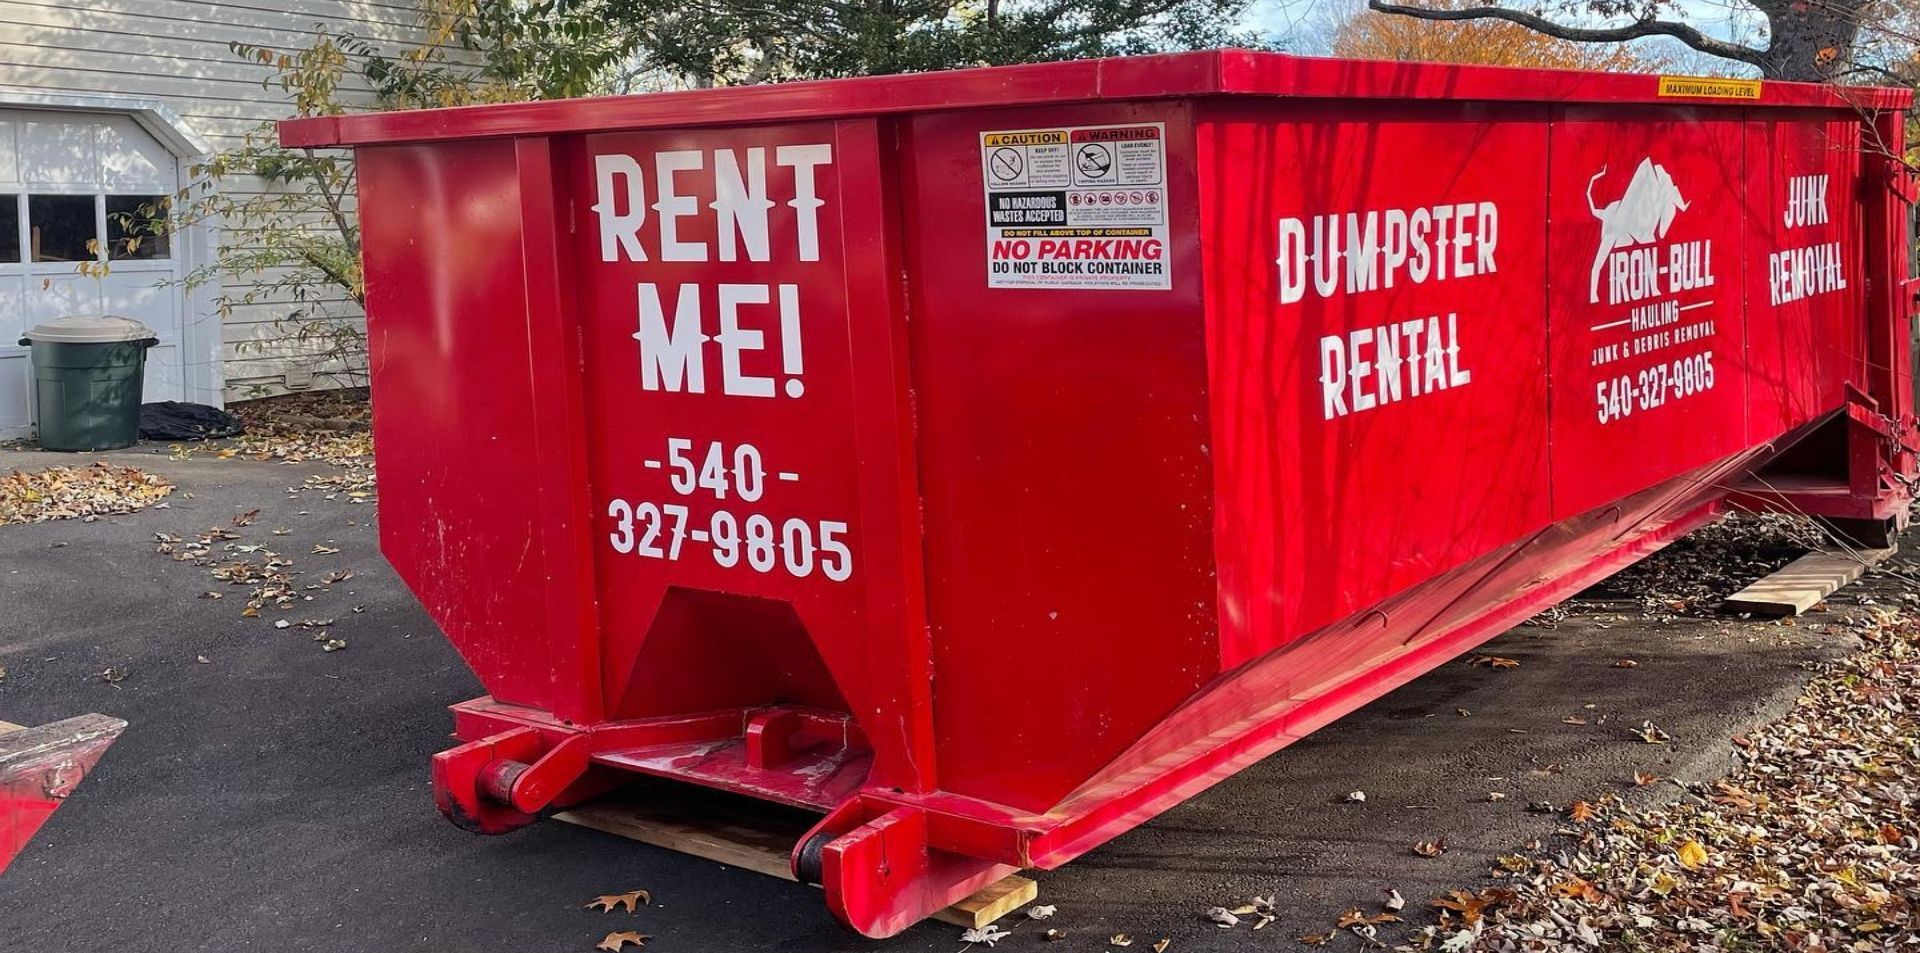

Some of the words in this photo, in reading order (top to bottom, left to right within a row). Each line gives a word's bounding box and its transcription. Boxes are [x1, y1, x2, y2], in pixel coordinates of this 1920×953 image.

[1666, 84, 1702, 94] MAXIMUM
[1703, 85, 1734, 95] LOADING
[1735, 87, 1755, 97] LEVEL
[1001, 133, 1061, 145] CAUTION
[1089, 129, 1154, 140] WARNING
[591, 144, 832, 262] RENT
[993, 210, 1024, 223] WASTES
[1025, 209, 1065, 222] ACCEPTED
[999, 198, 1010, 209] NO
[1012, 196, 1057, 209] HAZARDOUS
[1784, 175, 1829, 229] JUNK
[993, 240, 1030, 259] NO
[1037, 239, 1163, 259] PARKING
[993, 262, 1009, 274] DO
[1014, 262, 1037, 273] NOT
[1042, 262, 1083, 273] BLOCK
[1088, 262, 1162, 274] CONTAINER
[1276, 201, 1498, 305] DUMPSTER
[1609, 239, 1715, 306] IRON-BULL
[1769, 242, 1846, 307] REMOVAL
[632, 282, 805, 399] ME!
[1631, 300, 1680, 332] HAULING
[1319, 312, 1471, 421] RENTAL
[1591, 343, 1619, 366] JUNK
[1623, 341, 1630, 359] &
[1634, 331, 1670, 356] DEBRIS
[1674, 320, 1716, 344] REMOVAL
[1596, 351, 1714, 425] 540-327-9805
[608, 498, 853, 583] 327-9805
